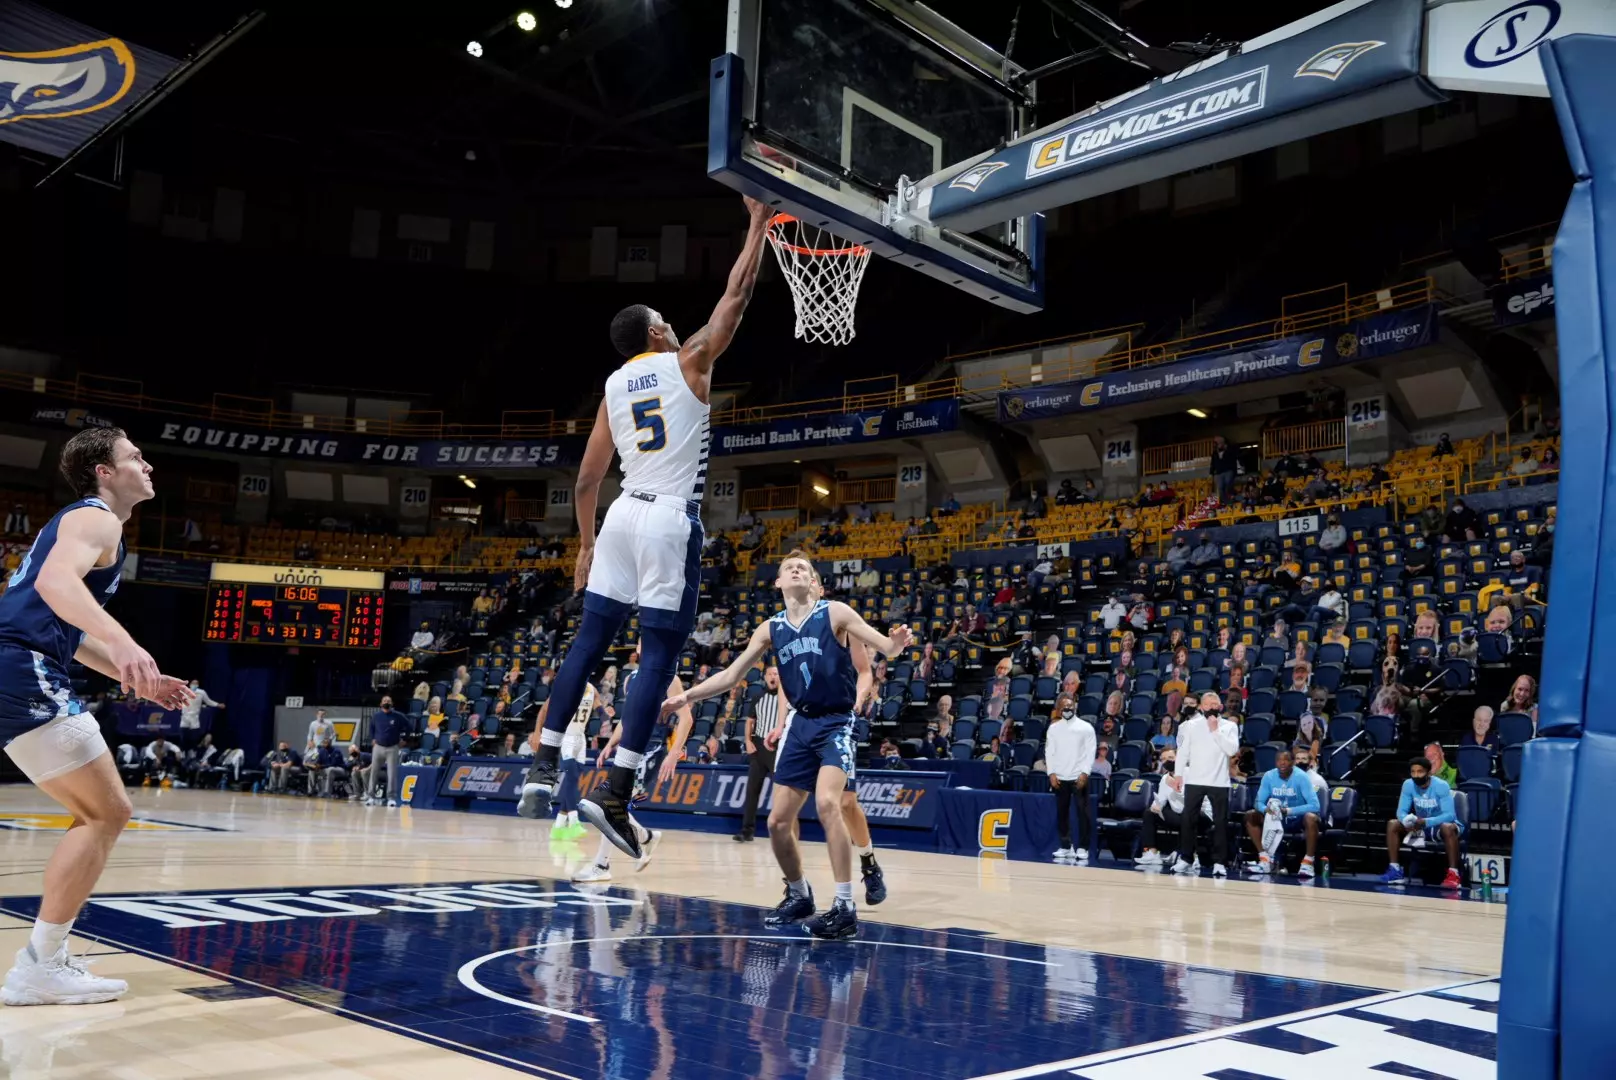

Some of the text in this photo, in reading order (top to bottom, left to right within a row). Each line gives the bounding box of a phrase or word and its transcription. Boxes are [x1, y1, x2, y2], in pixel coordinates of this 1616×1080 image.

[1025, 393, 1072, 410] erlanger
[1108, 376, 1162, 397] Exclusive
[1164, 367, 1231, 387] Healthcare
[1234, 355, 1290, 375] Provider
[1359, 323, 1421, 349] erlanger
[627, 374, 658, 392] BANKS
[1352, 400, 1380, 422] 215
[630, 396, 668, 453] 5
[723, 431, 765, 449] Official
[769, 428, 800, 444] Bank
[804, 425, 853, 440] Partner
[896, 416, 939, 431] FirstBank
[159, 422, 560, 462] EQUIPPING FOR SUCCESS
[1108, 440, 1131, 459] 214
[901, 466, 922, 482] 213
[242, 477, 267, 493] 210
[713, 481, 734, 497] 212
[404, 488, 426, 502] 210
[551, 490, 568, 504] 211
[1286, 518, 1310, 532] 115
[274, 569, 322, 585] unum
[284, 586, 317, 600] 16:06
[263, 608, 273, 620] 9
[332, 611, 341, 625] 2
[266, 626, 275, 637] 4
[282, 626, 297, 639] 33
[314, 628, 323, 640] 3
[799, 661, 812, 690] 1
[573, 708, 588, 723] 13
[467, 766, 500, 782] MOCS
[855, 782, 904, 802] MOCS
